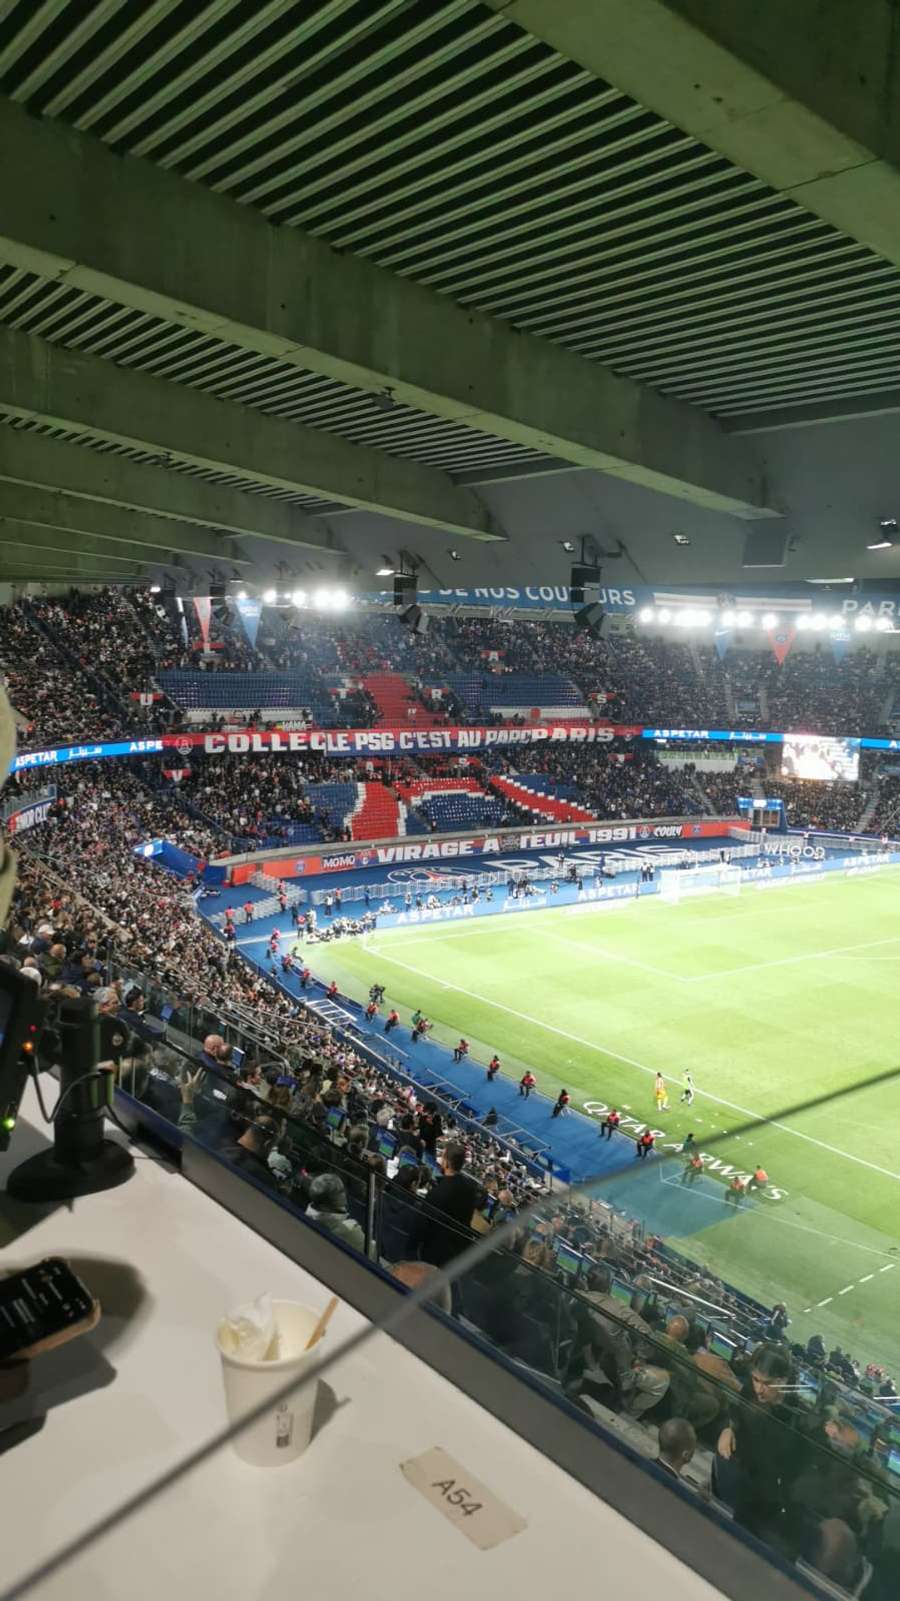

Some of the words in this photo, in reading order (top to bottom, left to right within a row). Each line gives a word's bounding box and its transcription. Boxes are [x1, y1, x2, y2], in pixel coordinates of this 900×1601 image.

[204, 732, 327, 753] COLLEC
[327, 732, 350, 752] LE
[354, 731, 396, 751] PSG
[400, 730, 452, 750] C'EST
[457, 730, 481, 748] AU
[530, 727, 615, 742] PARIS
[653, 728, 709, 738] ASPETAR
[129, 740, 164, 751] ASPE
[376, 840, 475, 863] VIRAGE
[587, 826, 637, 843] 1991
[396, 903, 475, 924] ASPETAR
[431, 1477, 483, 1518] A54
